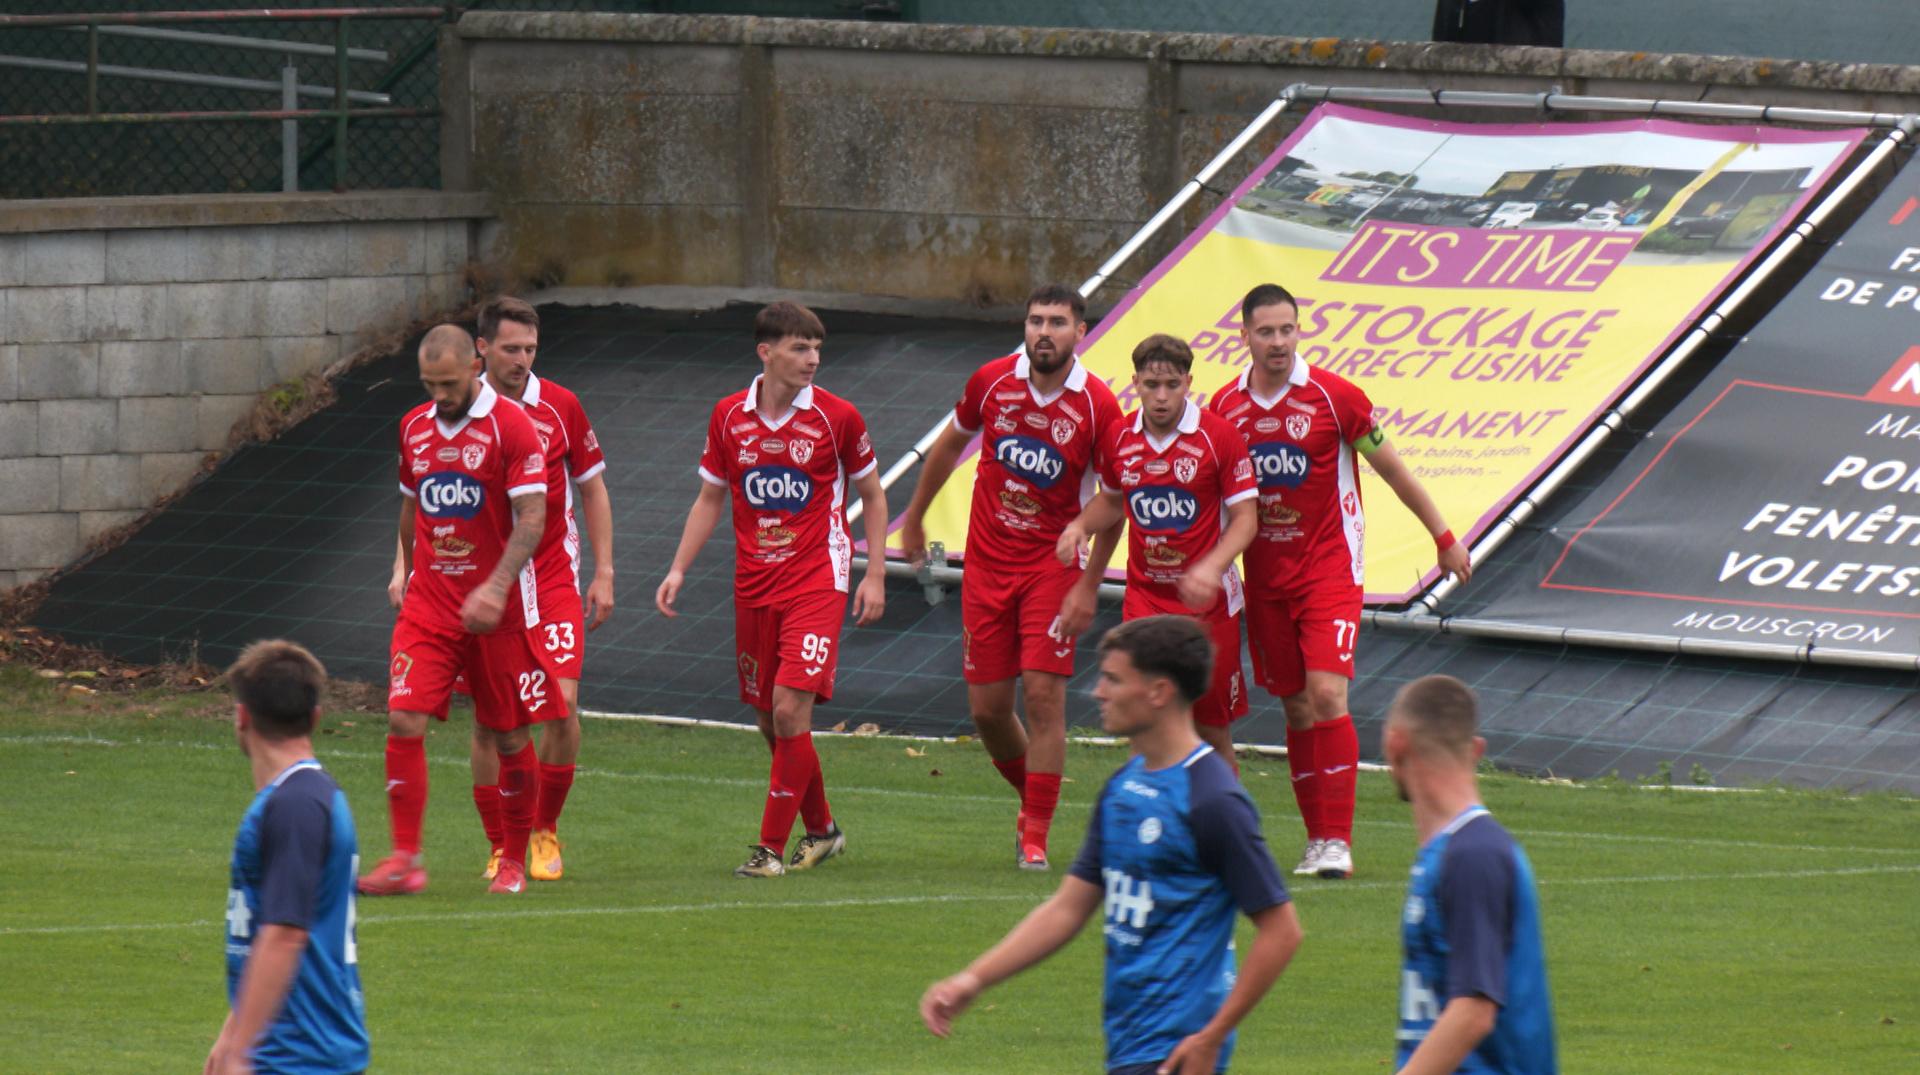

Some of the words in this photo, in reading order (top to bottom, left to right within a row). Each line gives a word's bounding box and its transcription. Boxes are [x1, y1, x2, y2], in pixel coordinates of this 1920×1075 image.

[1330, 226, 1460, 283] IT'S
[1461, 233, 1634, 288] TIME
[1819, 277, 1884, 306] DE
[1214, 297, 1619, 350] DSTOCKAGE
[1190, 331, 1253, 366] PRI
[1302, 345, 1451, 378] DIRECT
[1449, 351, 1583, 383] USINE
[997, 438, 1064, 481] Croky
[419, 477, 481, 514] Croky
[744, 470, 809, 506] Croky
[1130, 490, 1196, 525] Croky
[1742, 502, 1920, 547] FENÊT
[543, 621, 576, 652] 33
[1333, 618, 1356, 650] 77
[1672, 611, 1896, 644] MOUSCRON
[800, 632, 831, 664] 95
[518, 669, 547, 702] 22
